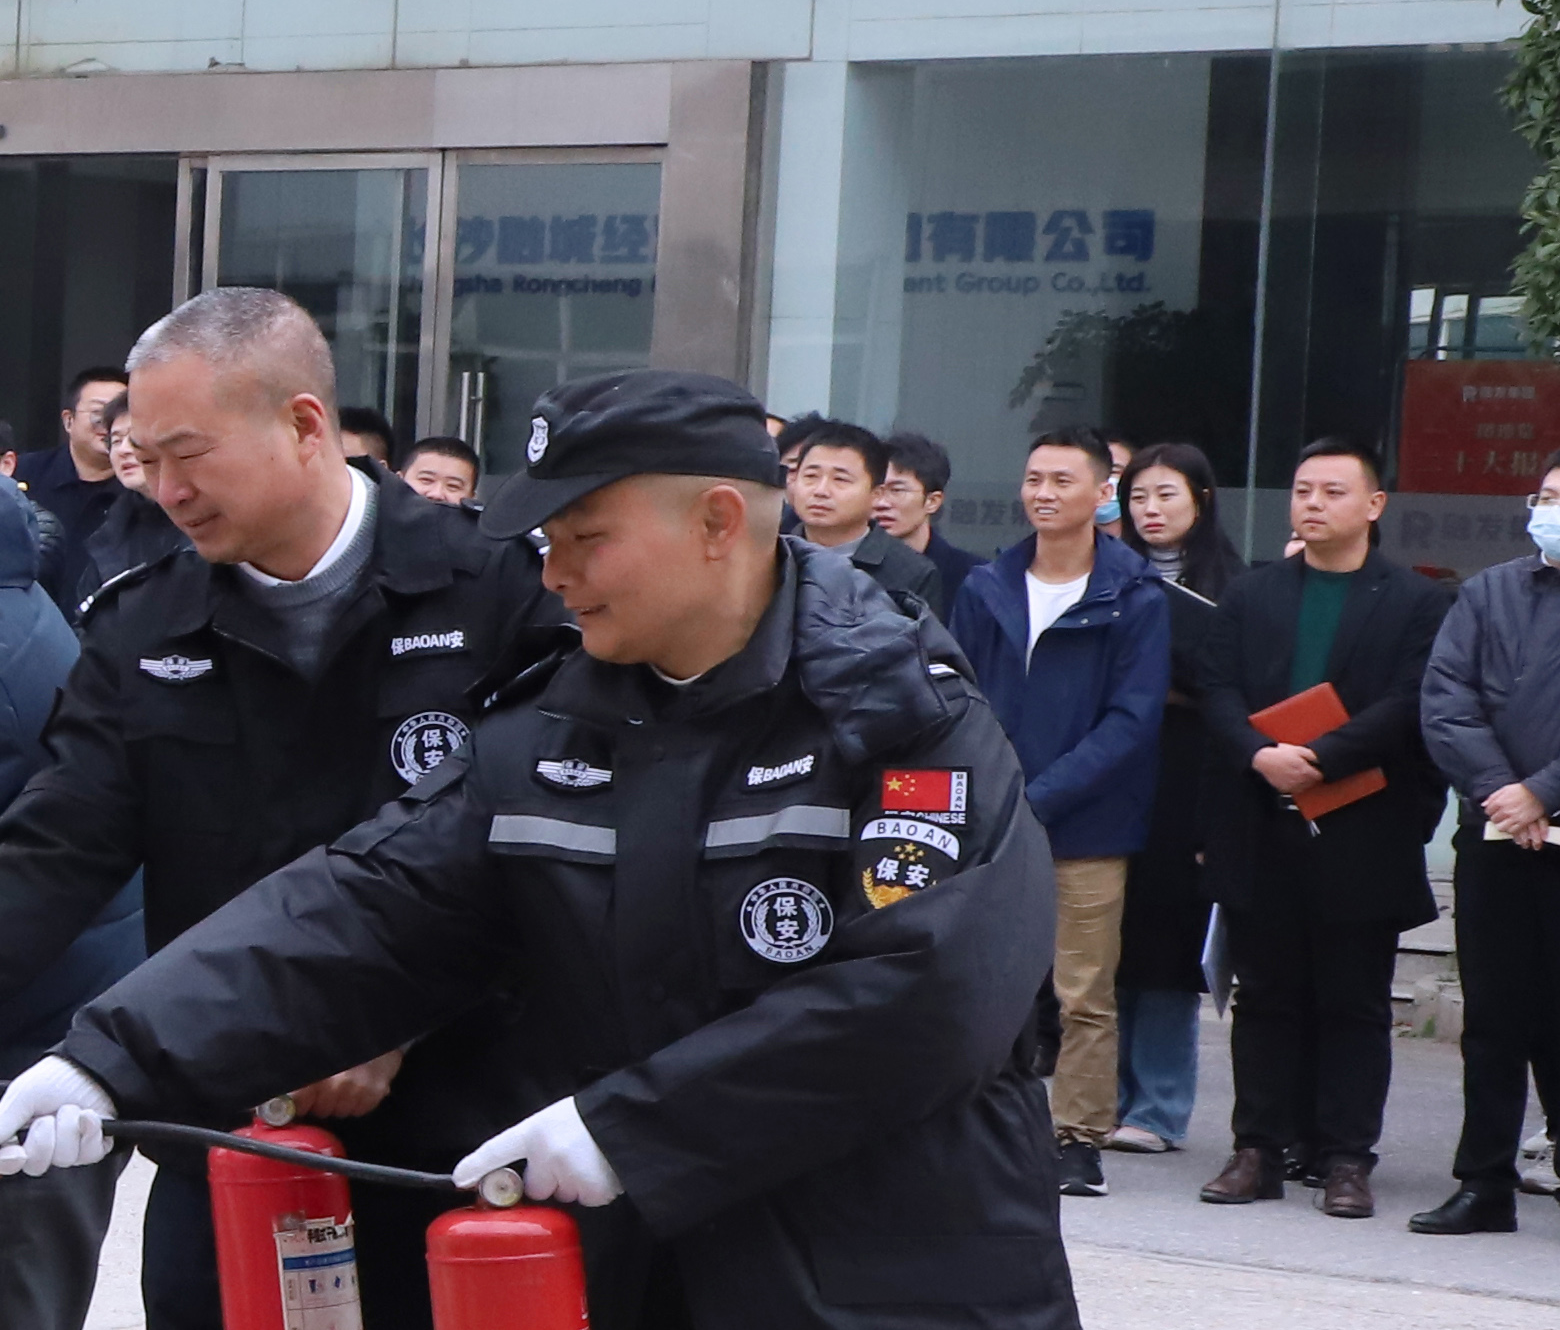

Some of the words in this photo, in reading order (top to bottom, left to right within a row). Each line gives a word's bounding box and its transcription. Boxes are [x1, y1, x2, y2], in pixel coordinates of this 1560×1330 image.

[876, 821, 952, 849] BAOAN
[876, 857, 930, 888] 保安
[773, 896, 799, 940] 保安
[766, 944, 813, 959] BAOAN
